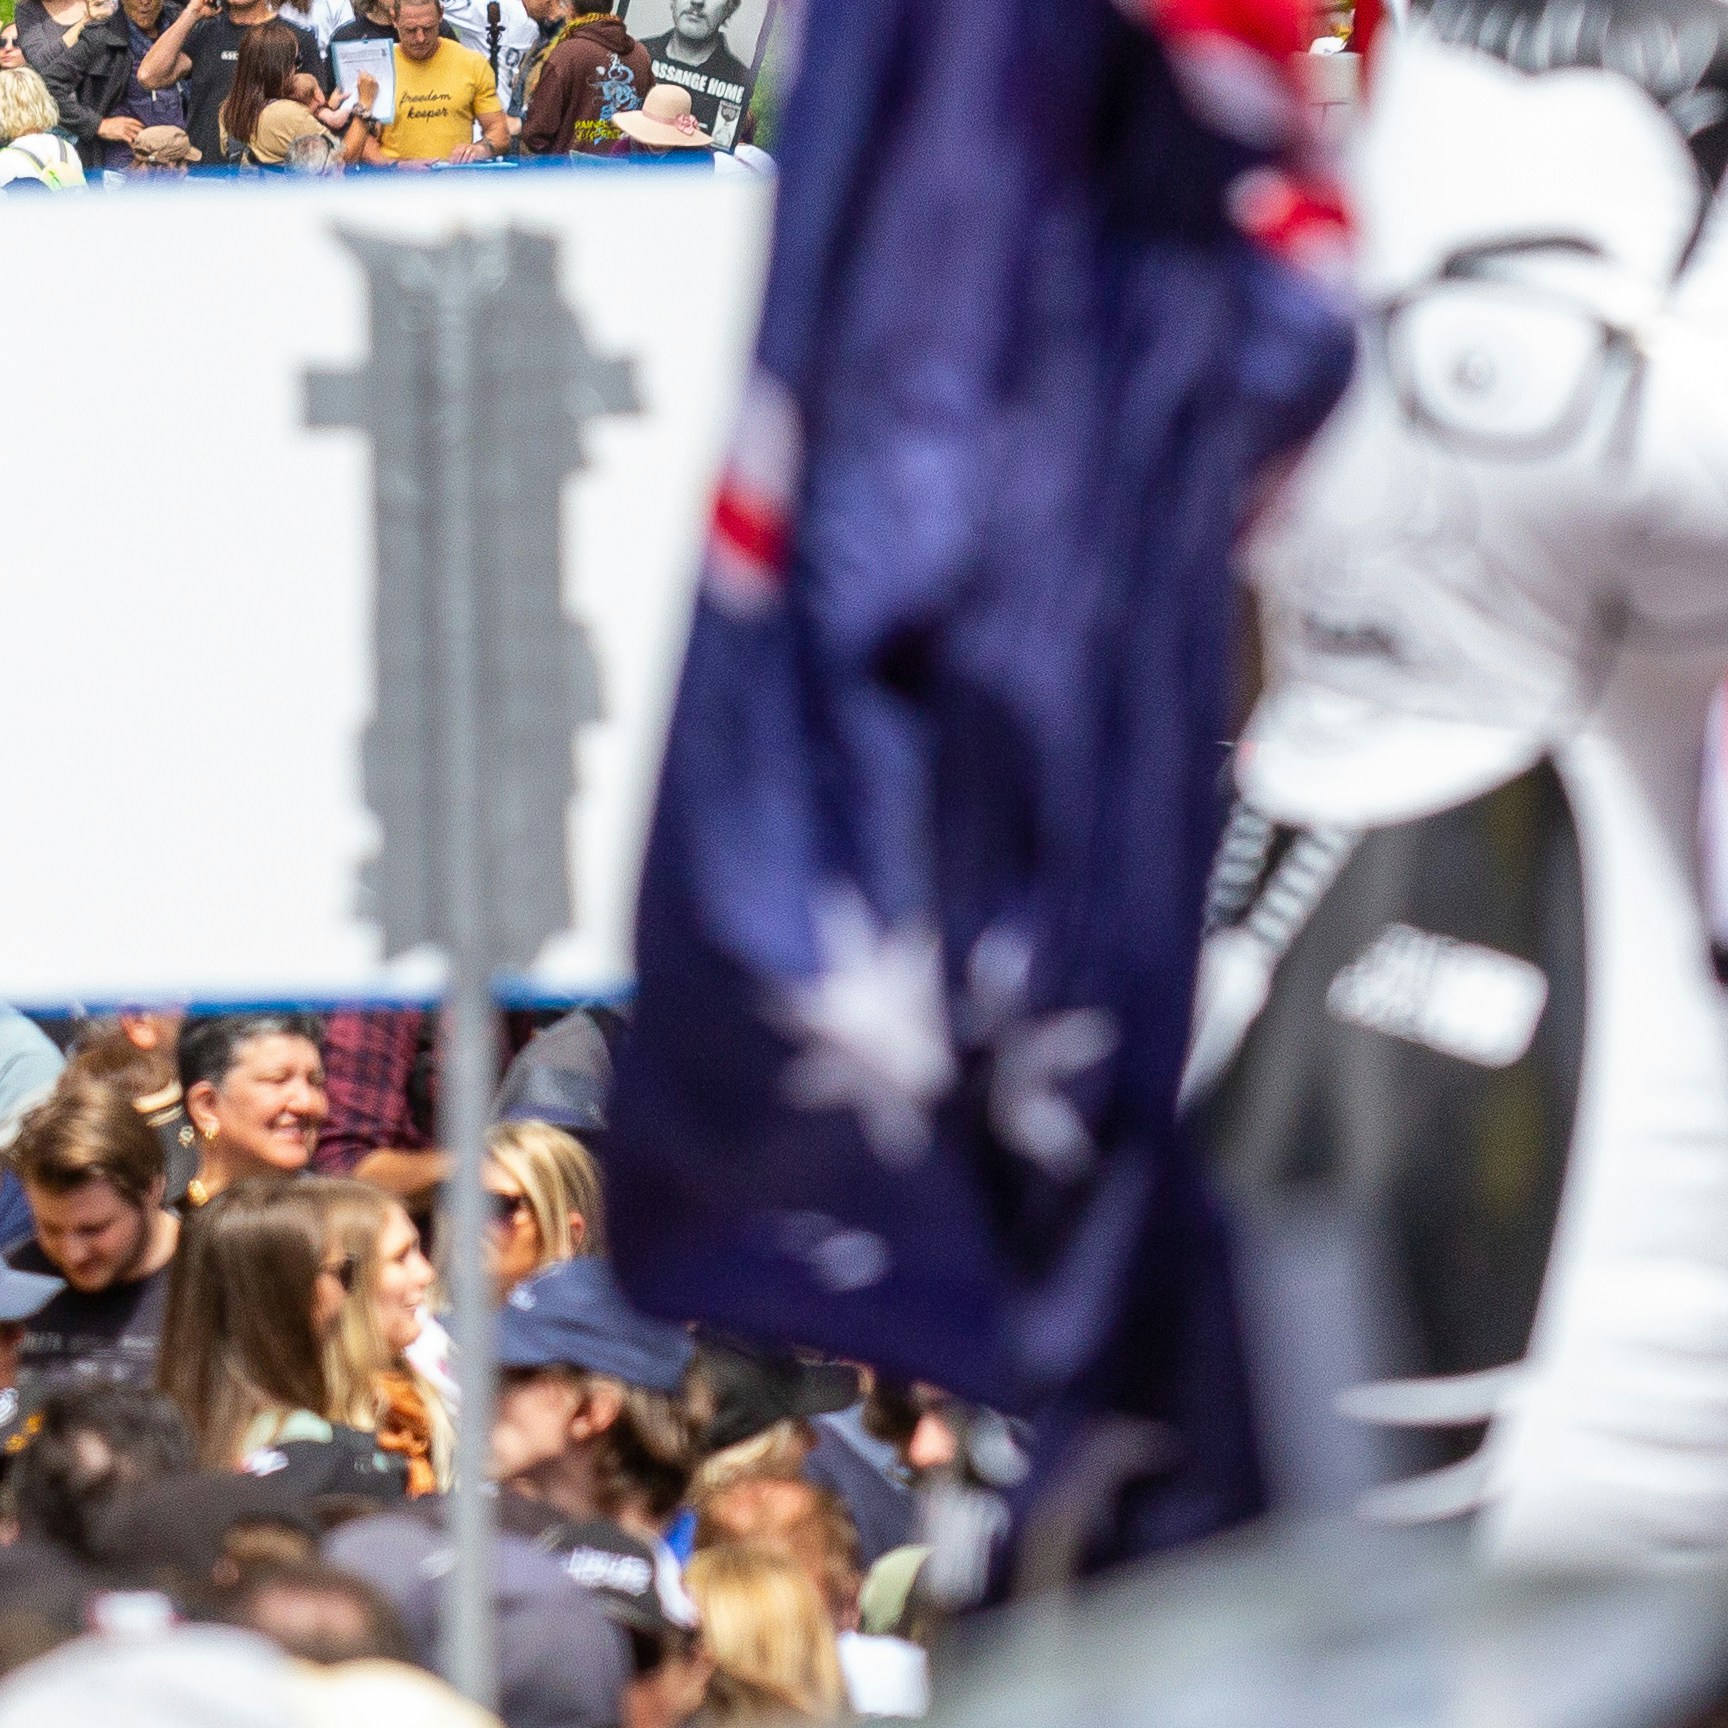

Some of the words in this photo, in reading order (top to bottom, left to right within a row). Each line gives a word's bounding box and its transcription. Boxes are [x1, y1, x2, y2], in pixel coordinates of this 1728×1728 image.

[651, 59, 707, 97] ASSANGE
[705, 78, 745, 103] HOME
[399, 88, 452, 109] freedom
[406, 106, 449, 123] keeper
